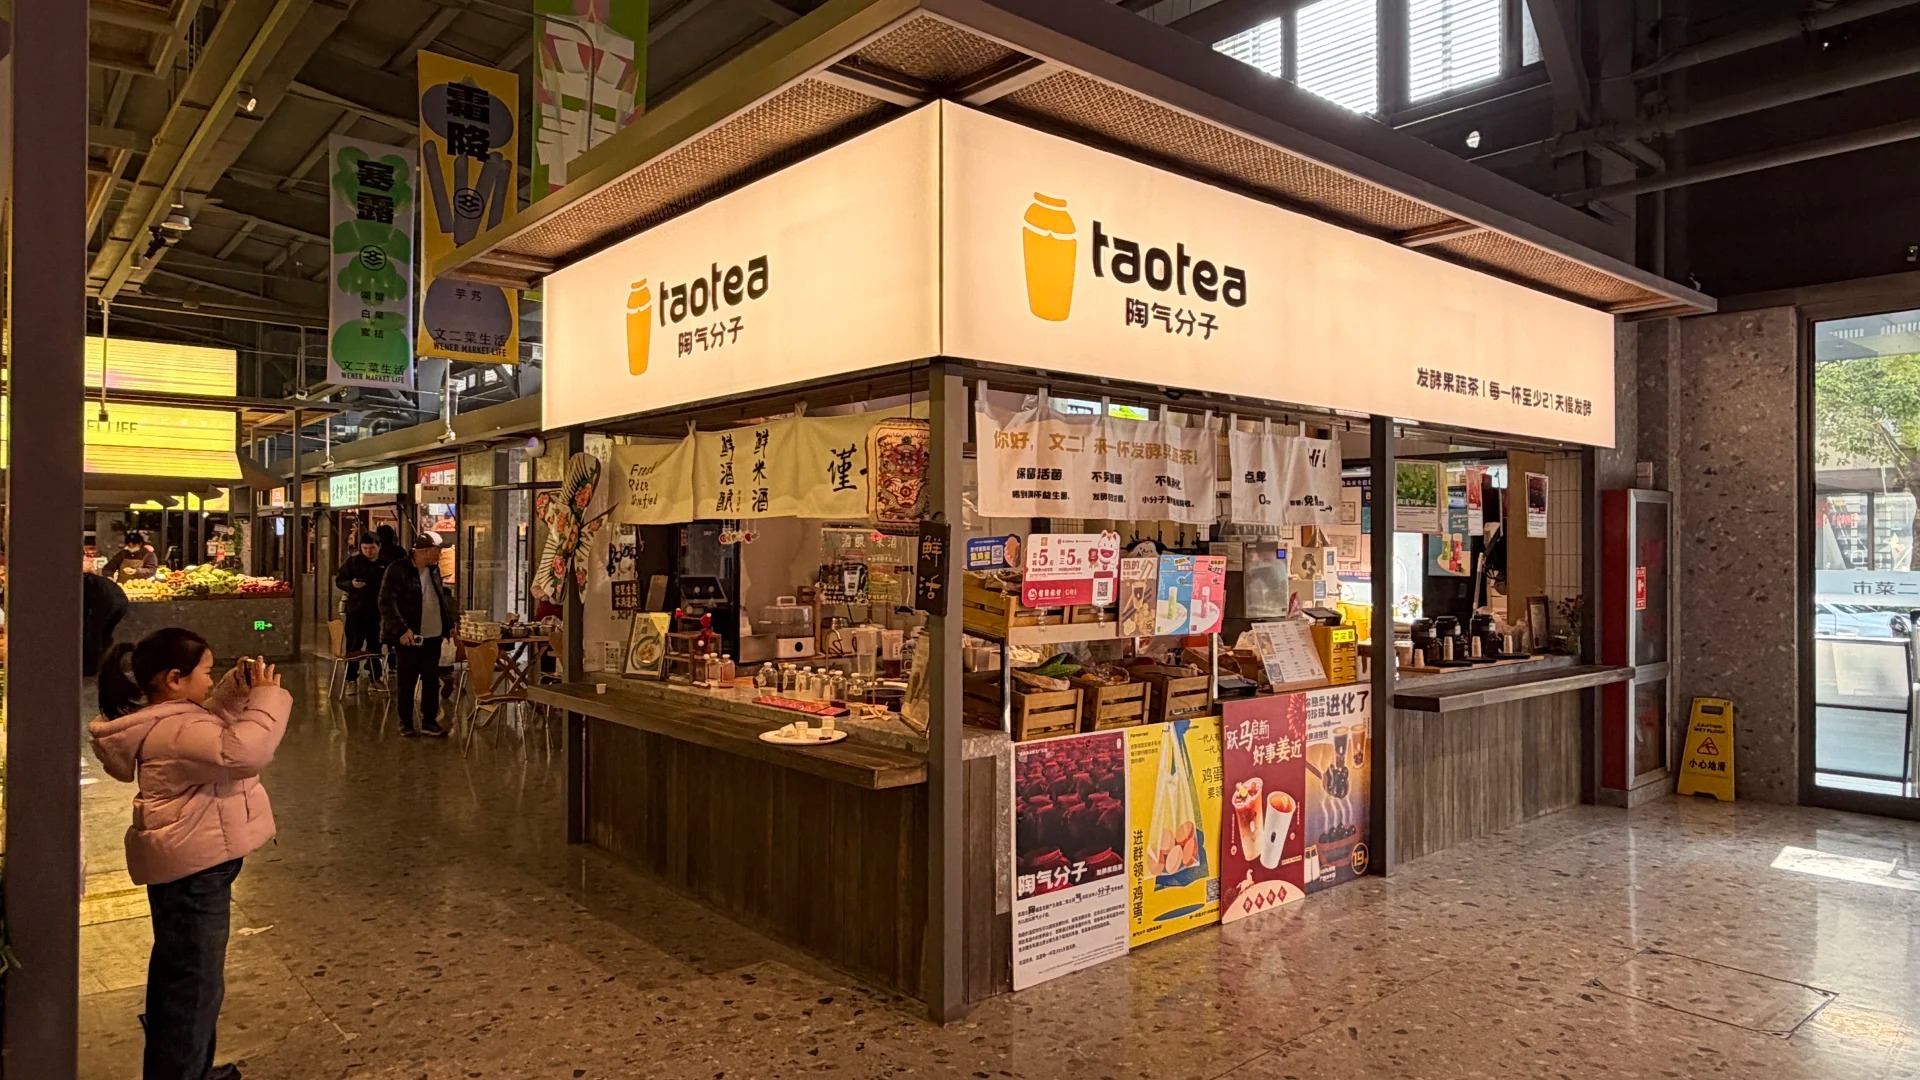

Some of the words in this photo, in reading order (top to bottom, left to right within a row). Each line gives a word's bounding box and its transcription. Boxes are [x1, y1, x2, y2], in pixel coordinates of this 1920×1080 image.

[446, 81, 490, 162] 霜降
[1092, 220, 1247, 308] taotea
[659, 255, 769, 327] taotea
[1125, 297, 1219, 340] 陶气分子
[434, 327, 507, 347] 文二菜生活
[678, 316, 744, 358] 陶气分子
[433, 342, 459, 351] WENER
[341, 372, 363, 380] WENER
[342, 360, 405, 376] 文二菜生活
[1016, 467, 1063, 481] 保留活菌
[1245, 471, 1266, 483] 点单
[1039, 549, 1048, 566] 5
[1067, 549, 1076, 566] 5
[1326, 691, 1369, 717] 进化了
[1689, 758, 1727, 773] 小心地滑
[1017, 861, 1088, 897] 陶气分子
